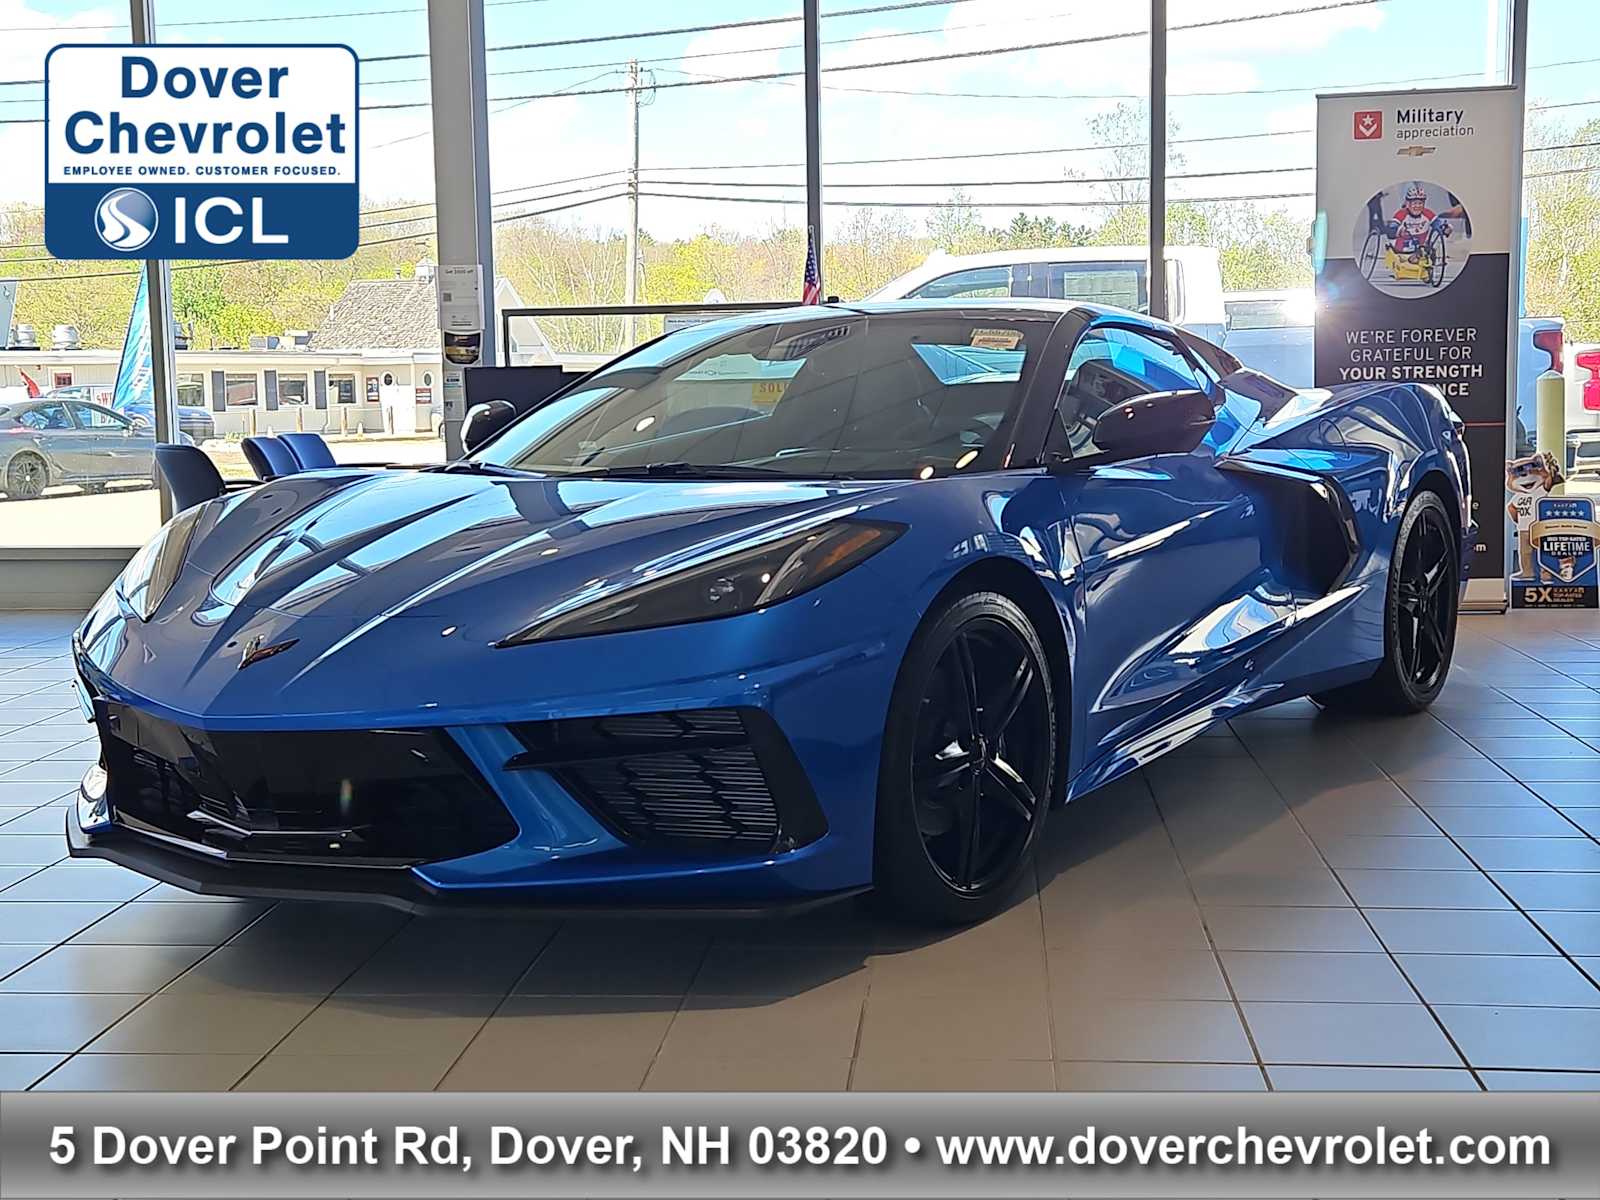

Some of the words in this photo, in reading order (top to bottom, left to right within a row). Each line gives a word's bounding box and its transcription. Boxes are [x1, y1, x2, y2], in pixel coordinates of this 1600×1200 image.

[1397, 108, 1464, 124] Military
[1396, 126, 1474, 140] appreciation
[1346, 329, 1395, 344] WE'RE
[1401, 328, 1477, 344] FOREVER
[1350, 346, 1434, 362] GRATEFUL
[1439, 346, 1472, 360] FOR
[1339, 366, 1386, 380] YOUR
[1391, 364, 1482, 380] STRENGTH
[1544, 541, 1590, 552] LIFETIME
[1524, 587, 1552, 602] 5X
